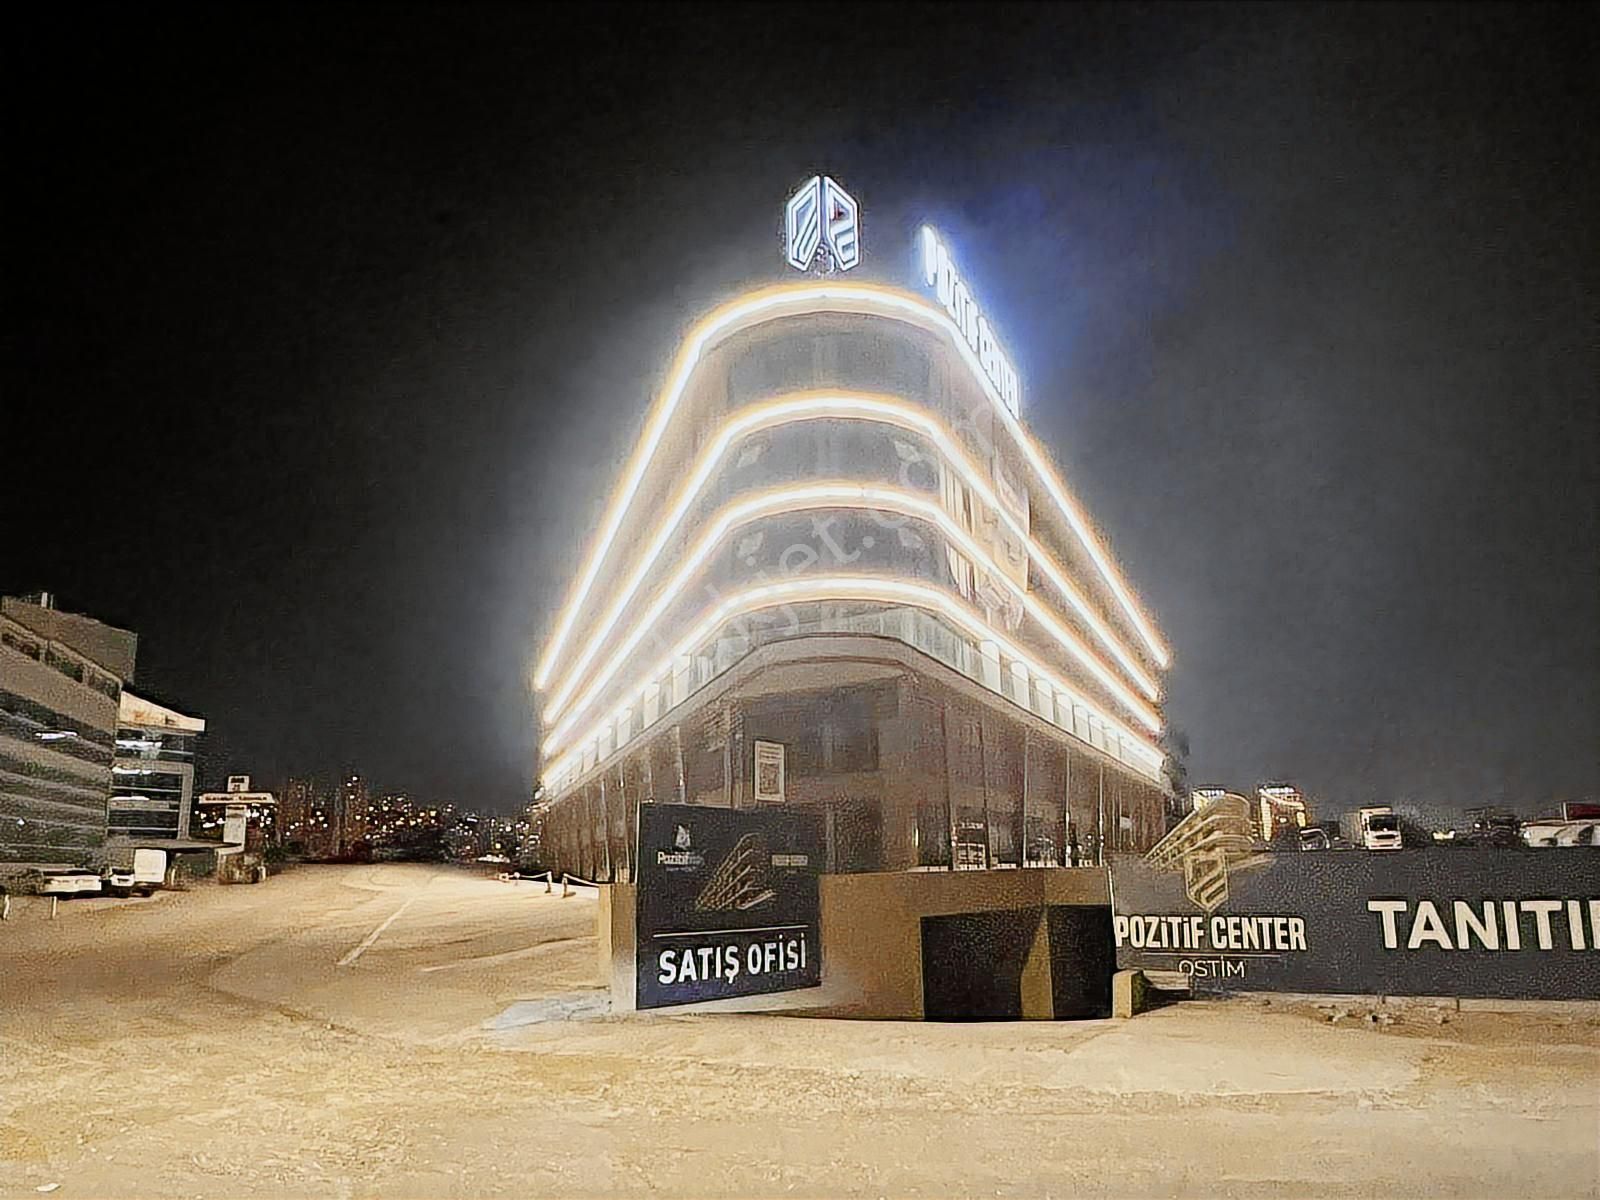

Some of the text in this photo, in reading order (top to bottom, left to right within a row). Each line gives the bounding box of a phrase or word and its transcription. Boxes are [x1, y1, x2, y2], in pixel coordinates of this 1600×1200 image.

[1210, 916, 1307, 951] CENTER
[1367, 900, 1600, 952] TANITI
[657, 932, 807, 985] SATIŞ OFİSİ
[1178, 954, 1245, 979] OSTİM
